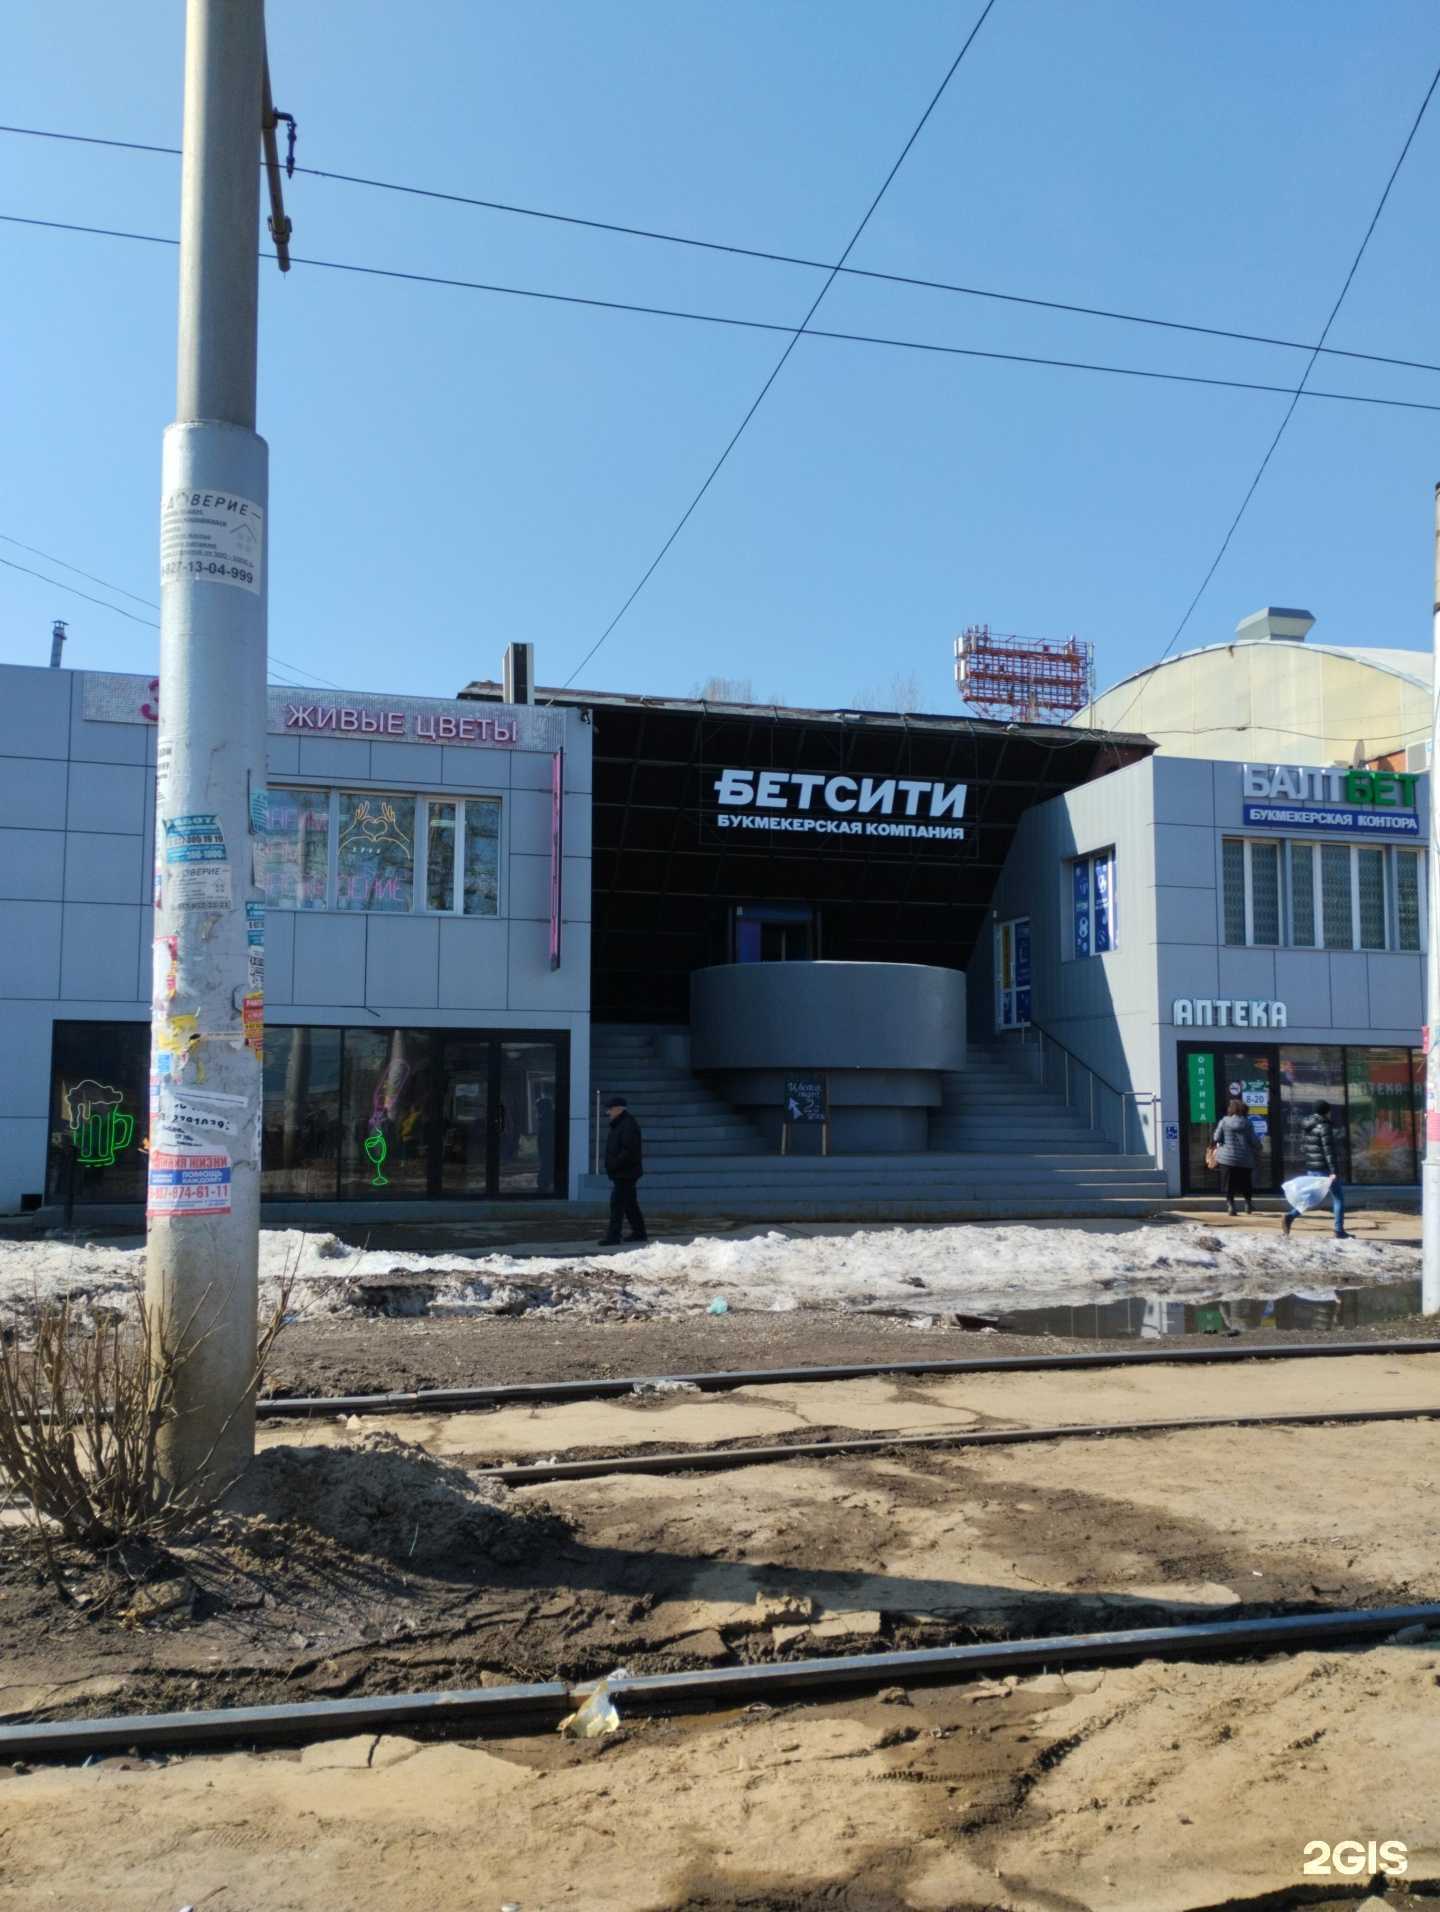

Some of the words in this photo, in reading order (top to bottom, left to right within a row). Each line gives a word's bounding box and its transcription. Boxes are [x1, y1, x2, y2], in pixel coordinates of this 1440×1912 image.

[287, 703, 405, 736] ЖИВЫЕ
[416, 714, 518, 743] ЦВЕТЫ
[713, 769, 968, 818] БЕТСИТИ
[1243, 764, 1421, 808] БАЛТБЕТ
[717, 814, 863, 835] БУКМЕКЕРСКАЯ
[865, 822, 964, 840] КОМПАНИЯ
[1250, 808, 1353, 826] БУКМЕКЕРСКАЯ
[1358, 815, 1417, 829] КОНТОРА
[1173, 998, 1288, 1028] АПТЕКА
[1196, 1056, 1208, 1121] ОПТИКА
